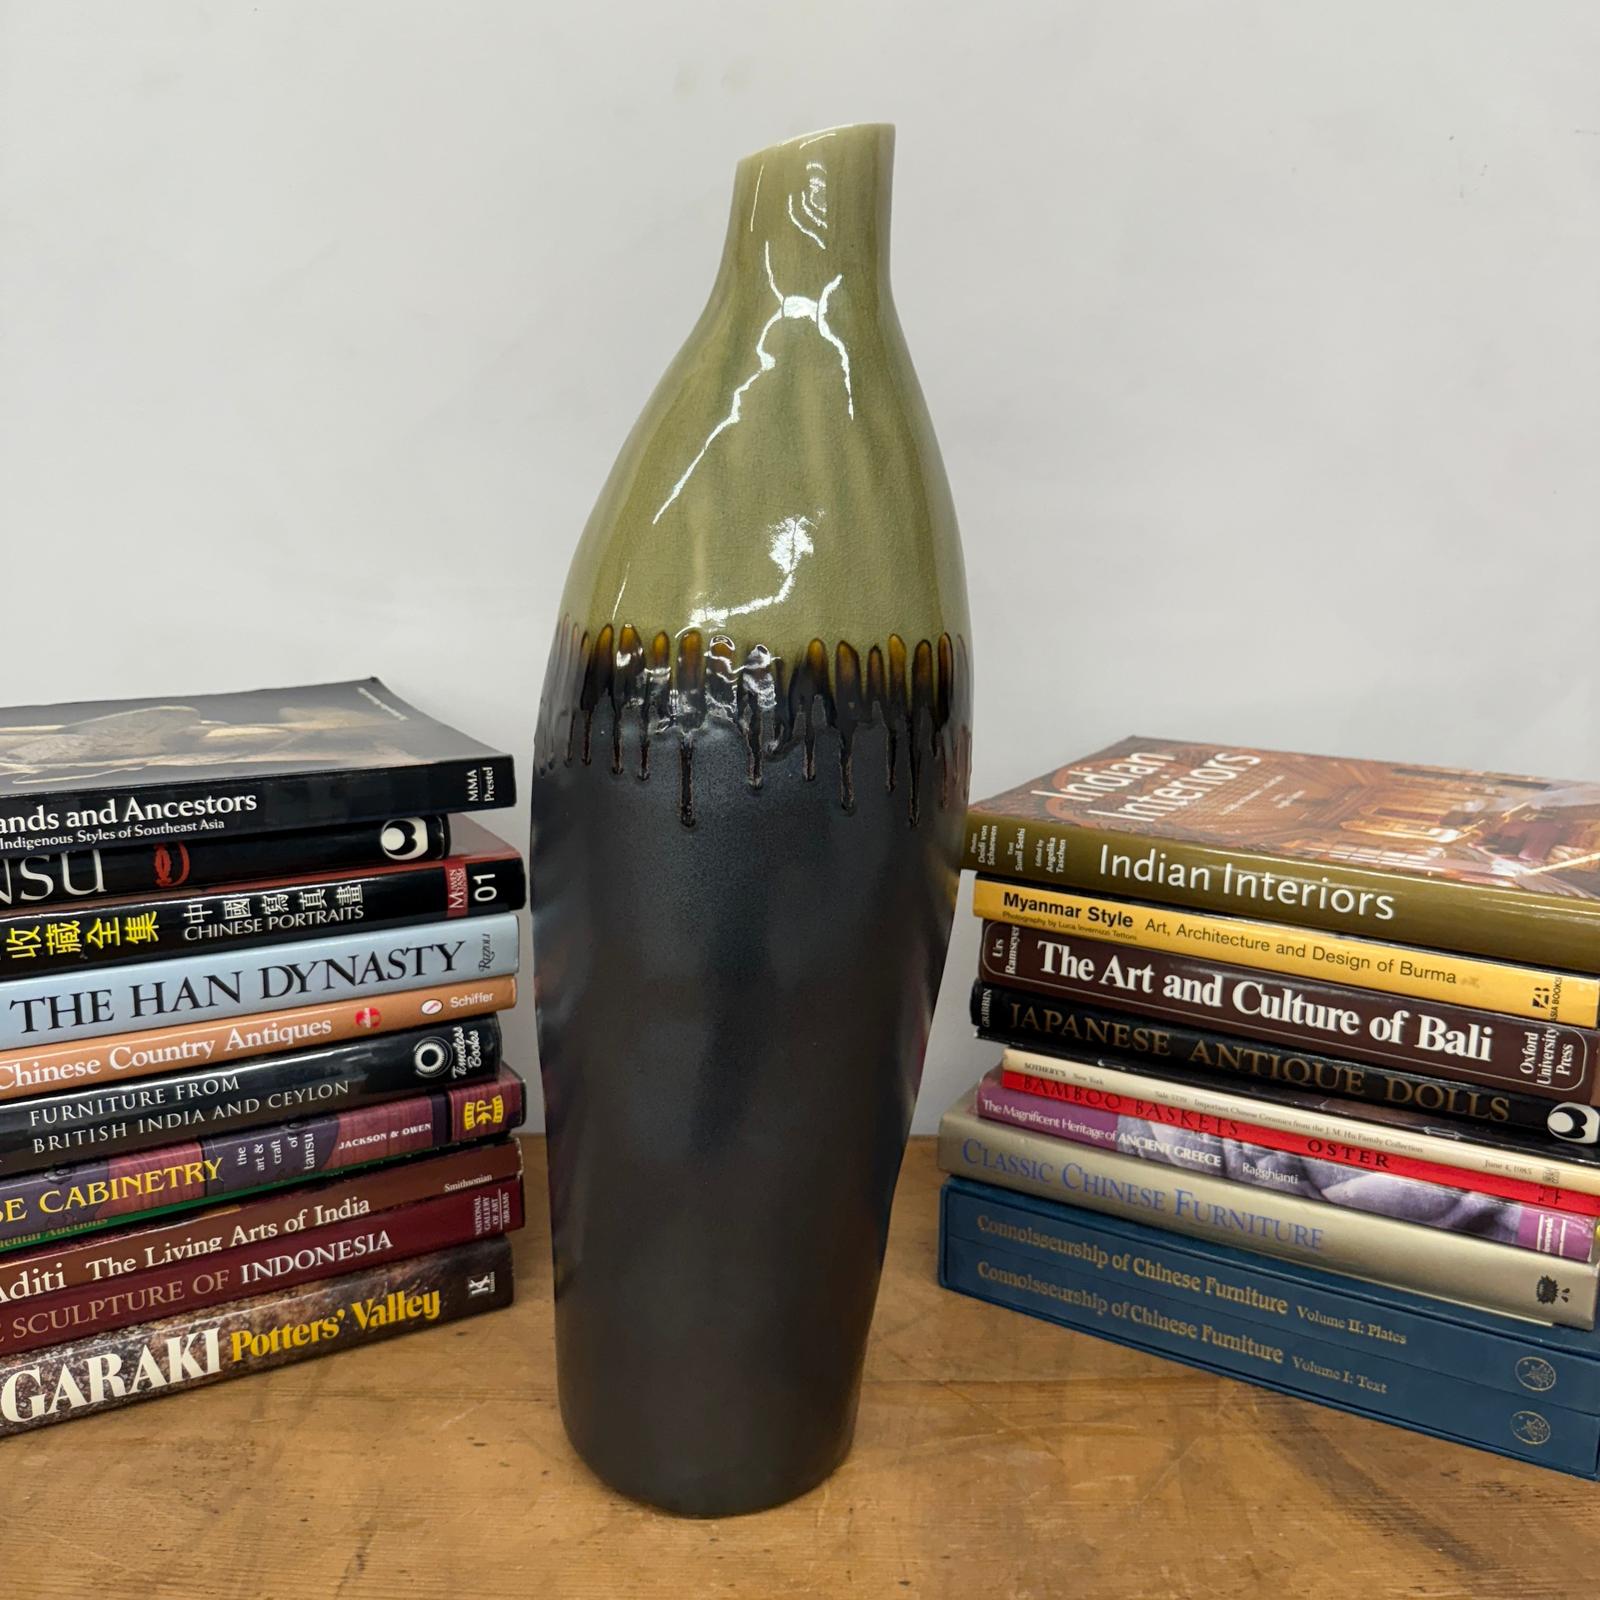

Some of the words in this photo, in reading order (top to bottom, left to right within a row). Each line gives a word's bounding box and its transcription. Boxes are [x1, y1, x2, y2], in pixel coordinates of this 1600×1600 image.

[467, 769, 479, 802] MMA
[483, 766, 495, 802] Prestel
[1030, 751, 1176, 802] Indian
[1086, 752, 1262, 822] Interiors
[66, 797, 118, 828] and
[123, 795, 257, 823] Ancestors
[0, 836, 73, 851] Indigenous
[77, 829, 116, 844] Styles
[119, 826, 133, 838] of
[134, 821, 198, 836] Southeast
[199, 820, 225, 831] Asia
[980, 825, 988, 840] von
[1016, 828, 1025, 849] Sethi
[1015, 850, 1023, 871] Sunil
[1046, 837, 1056, 873] Angelika
[1056, 839, 1066, 873] Taschen
[473, 873, 497, 902] 01
[1100, 844, 1210, 891] Indian
[1223, 862, 1395, 921] Interiors
[6, 911, 160, 959] 收藏全集
[184, 918, 263, 941] CHINESE
[268, 905, 364, 931] PORTRAITS
[1002, 911, 1046, 925] Photography
[1059, 921, 1076, 930] Luca
[1003, 892, 1082, 918] Myanmar
[1088, 906, 1134, 928] Style
[1145, 918, 1170, 937] Art,
[1176, 923, 1270, 952] Architecture
[1275, 944, 1306, 958] and
[1312, 946, 1370, 971] Design
[1377, 958, 1395, 973] of
[1399, 961, 1456, 984] Burma
[992, 938, 1004, 958] Urs
[1004, 926, 1020, 975] Ramseyer
[9, 989, 115, 1034] THE
[129, 970, 243, 1018] HAN
[258, 941, 466, 1000] DYNASTY
[450, 992, 494, 1008] Schiffer
[1037, 939, 1095, 981] The
[1099, 955, 1155, 993] Art
[1162, 974, 1222, 1008] and
[1232, 981, 1361, 1036] Culture
[1369, 1009, 1410, 1045] of
[1414, 1014, 1493, 1062] Bali
[0, 1059, 101, 1090] Chinese
[109, 1039, 216, 1071] Country
[224, 1020, 333, 1052] Antiques
[465, 1030, 481, 1068] Books
[1009, 1003, 1171, 1056] JAPANESE
[1188, 1039, 1366, 1096] ANTIQUE
[1384, 1075, 1510, 1122] DOLLS
[1519, 1031, 1539, 1075] Oxford
[1537, 1027, 1560, 1085] University
[1556, 1043, 1574, 1077] Press
[30, 1088, 166, 1127] FURNITURE
[176, 1075, 240, 1100] FROM
[33, 1122, 127, 1154] BRITISH
[139, 1109, 206, 1134] INDIA
[212, 1098, 260, 1120] AND
[268, 1080, 350, 1109] CEYLON
[338, 1133, 388, 1150] JACKSON
[390, 1130, 399, 1139] &
[402, 1122, 431, 1136] OWEN
[1024, 1075, 1121, 1110] BAMBOO
[1135, 1099, 1239, 1136] BASKETS
[1307, 1139, 1390, 1168] OSTER
[237, 1147, 247, 1166] the
[254, 1143, 264, 1155] &
[273, 1139, 282, 1165] craft
[289, 1135, 298, 1148] of
[304, 1133, 314, 1170] tansu
[983, 1099, 1001, 1112] The
[1002, 1104, 1060, 1128] Magnificent
[1062, 1118, 1105, 1140] Heritage
[1105, 1128, 1118, 1141] of
[1117, 1132, 1171, 1156] ANCIENT
[1173, 1144, 1223, 1168] GREECE
[1242, 1162, 1299, 1185] Ragghianti
[256, 1156, 264, 1172] art
[444, 1173, 492, 1193] Smithsonian
[0, 1197, 28, 1223] E
[39, 1157, 223, 1214] CABINETRY
[962, 1138, 1053, 1183] CLASSIC
[1061, 1162, 1166, 1211] CHINESE
[1174, 1189, 1324, 1250] FURNITURE
[85, 1256, 137, 1281] The
[144, 1236, 223, 1268] Living
[229, 1221, 278, 1248] Arts
[285, 1208, 308, 1233] of
[314, 1196, 371, 1226] India
[12, 1280, 185, 1340] SCULPTURE
[192, 1269, 231, 1295] OF
[240, 1230, 394, 1285] INDONESIA
[977, 1215, 1108, 1268] Connoisseurship
[1112, 1254, 1130, 1271] of
[1133, 1257, 1201, 1292] Chinese
[1205, 1276, 1288, 1315] Furniture
[1296, 1305, 1345, 1329] Volume
[1368, 1322, 1407, 1344] Plates
[977, 1261, 1108, 1313] Connoisseurship
[1111, 1301, 1129, 1318] of
[1131, 1304, 1198, 1338] Chinese
[1201, 1324, 1284, 1364] Furniture
[1292, 1356, 1340, 1381] Volume
[1356, 1373, 1387, 1394] Text
[0, 1327, 222, 1423] GARAKI
[352, 1290, 441, 1330] Valley
